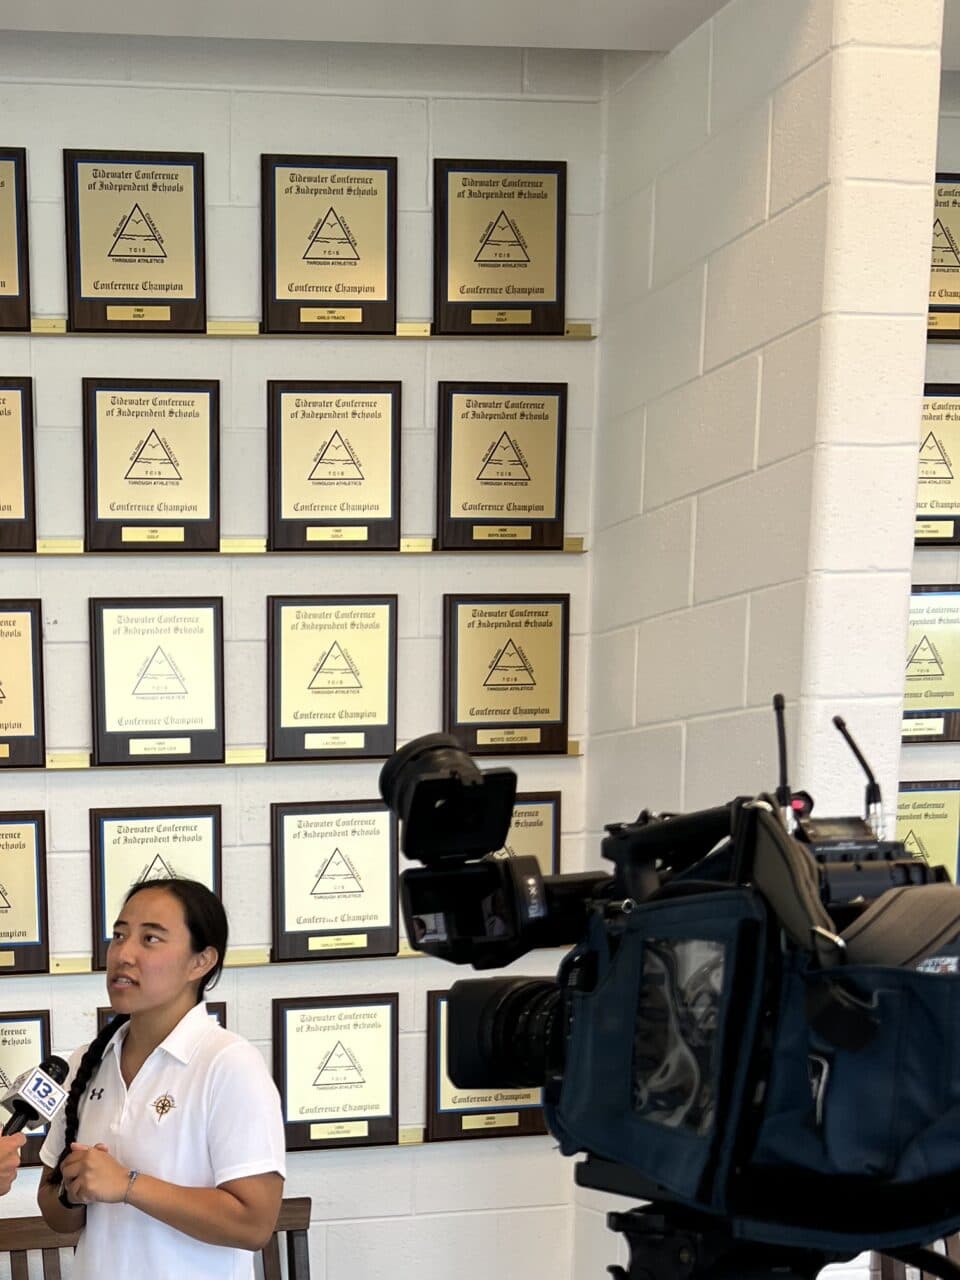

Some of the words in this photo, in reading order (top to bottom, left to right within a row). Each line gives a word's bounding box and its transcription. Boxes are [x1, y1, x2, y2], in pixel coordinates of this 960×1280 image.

[92, 169, 133, 179] Tidewater
[135, 170, 179, 180] Conference
[289, 173, 328, 183] Tidewater
[330, 174, 373, 184] Conference
[88, 181, 96, 190] of
[98, 181, 148, 193] Independent
[152, 182, 184, 194] Schools
[462, 178, 500, 187] Tidewater
[502, 178, 543, 188] Conference
[285, 185, 293, 194] of
[295, 185, 343, 197] Independent
[347, 186, 378, 197] Schools
[457, 190, 465, 198] of
[467, 189, 514, 200] Independent
[518, 190, 548, 200] Schools
[93, 280, 139, 291] Conference
[142, 281, 183, 293] Champion
[288, 283, 332, 293] Conference
[335, 283, 375, 295] Champion
[459, 285, 503, 294] Conference
[505, 285, 545, 296] Champion
[295, 399, 333, 408] Tidewater
[335, 399, 377, 408] Conference
[290, 411, 299, 419] of
[300, 410, 348, 420] Independent
[351, 410, 382, 420] Schools
[293, 502, 337, 512] Conference
[340, 502, 379, 513] Champion
[472, 609, 508, 618] Tidewater
[509, 609, 549, 617] Conference
[467, 620, 475, 628] of
[477, 619, 521, 630] Independent
[524, 619, 553, 629] Schools
[469, 707, 510, 716] Conference
[513, 705, 550, 716] Champion
[2, 1036, 31, 1047] Schools
[31, 1077, 53, 1098] 13
[452, 1095, 491, 1104] Conference
[494, 1093, 531, 1103] Champion
